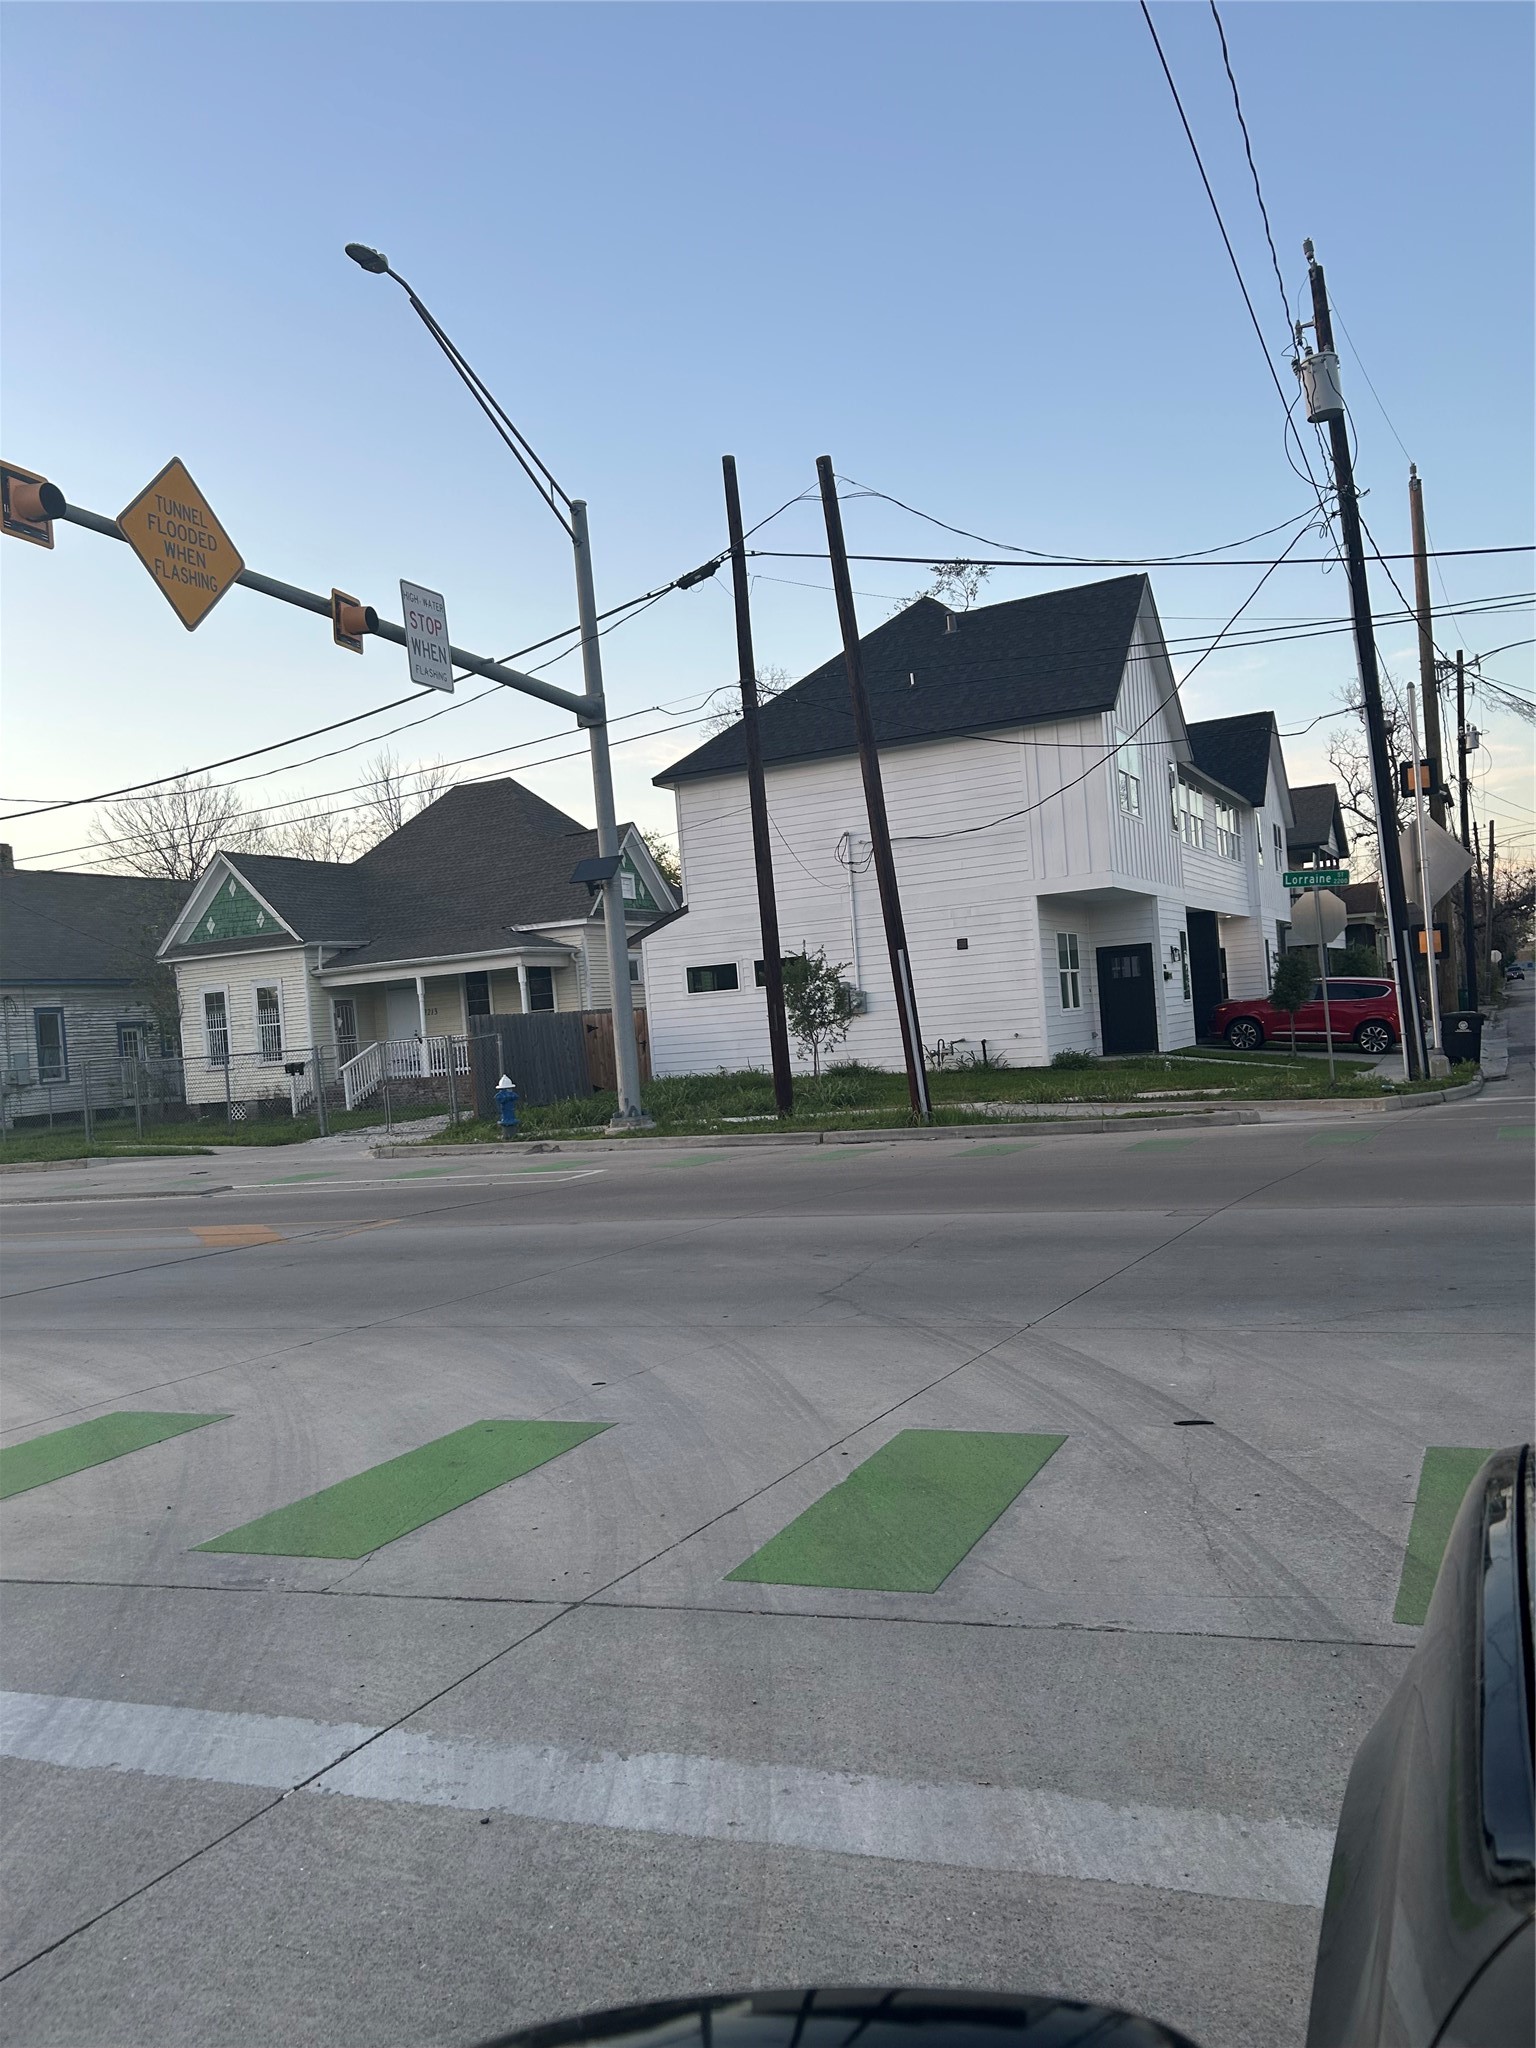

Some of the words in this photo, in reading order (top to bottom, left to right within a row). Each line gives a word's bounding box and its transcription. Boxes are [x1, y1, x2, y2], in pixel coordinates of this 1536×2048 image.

[155, 494, 208, 529] TUNNEL
[147, 513, 217, 552] FLOODED
[164, 540, 206, 569] WHEN
[154, 558, 217, 593] FLASHING
[409, 610, 442, 636] STOP
[410, 636, 447, 665] WHEN
[415, 664, 448, 683] FLASHING
[1285, 873, 1332, 885] Lorraine
